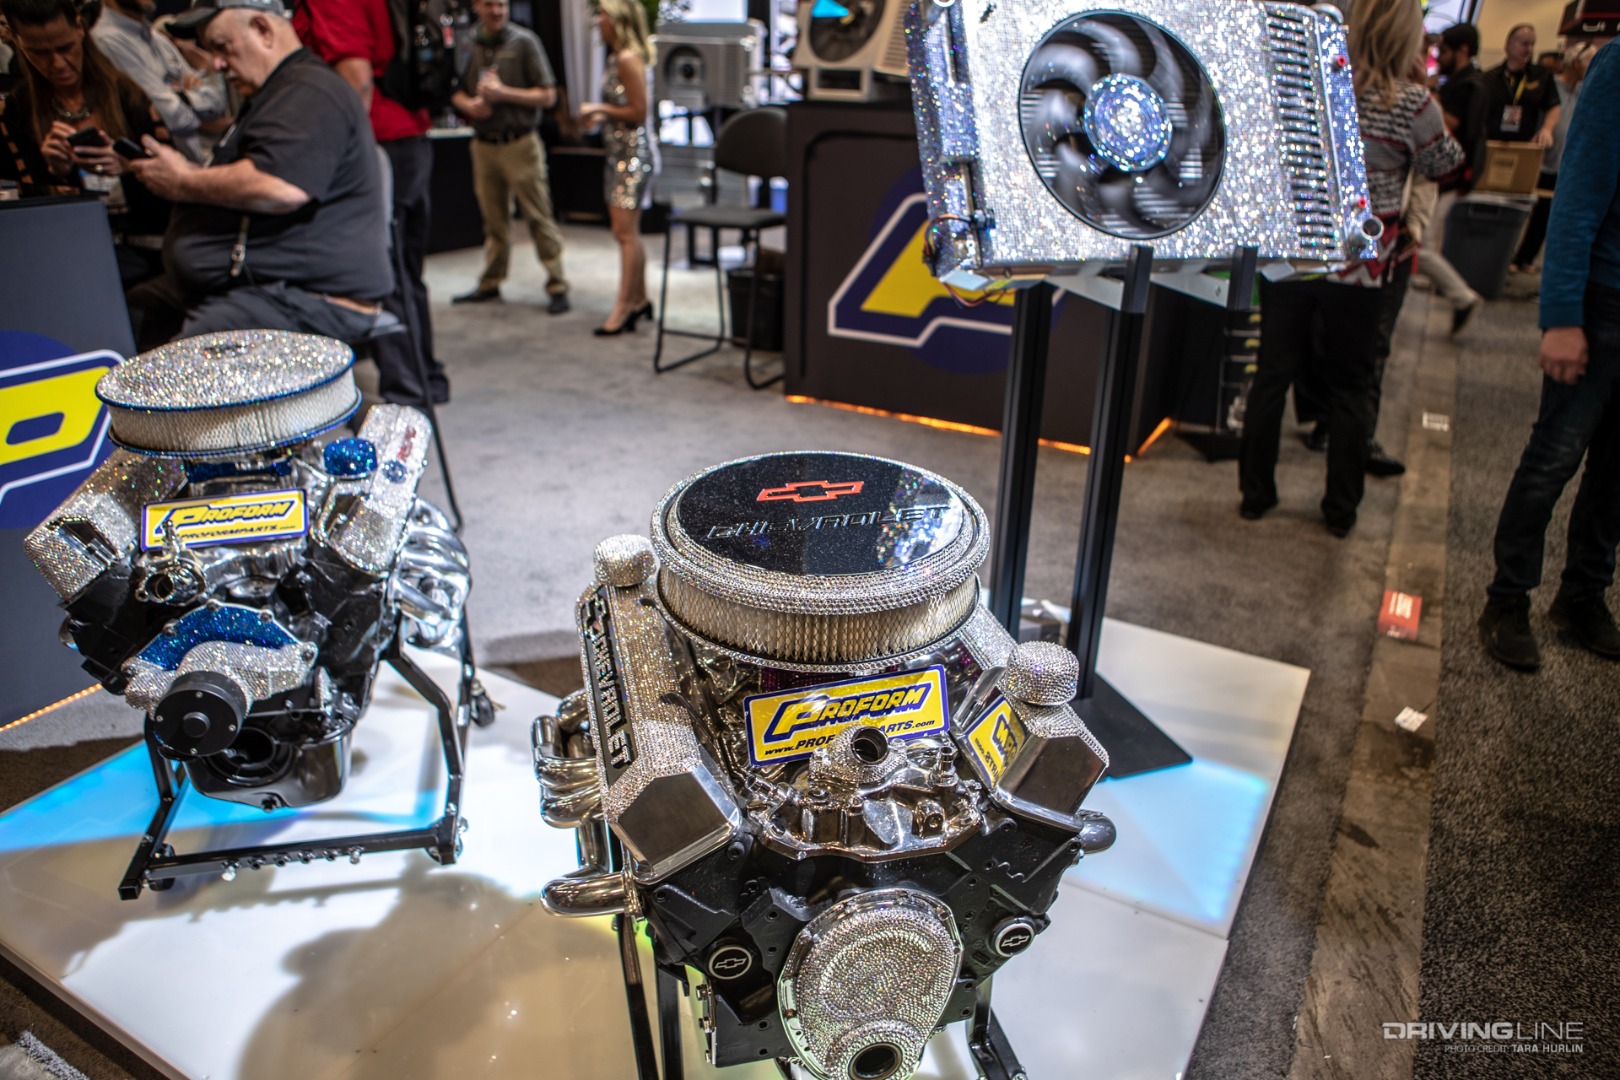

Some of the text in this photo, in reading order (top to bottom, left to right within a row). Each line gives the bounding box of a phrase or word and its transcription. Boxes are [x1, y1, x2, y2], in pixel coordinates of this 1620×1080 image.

[156, 501, 295, 533] PROFORM
[706, 505, 951, 540] CHEVROLET
[592, 635, 632, 768] CHEVROLET
[766, 682, 932, 742] PROFORM
